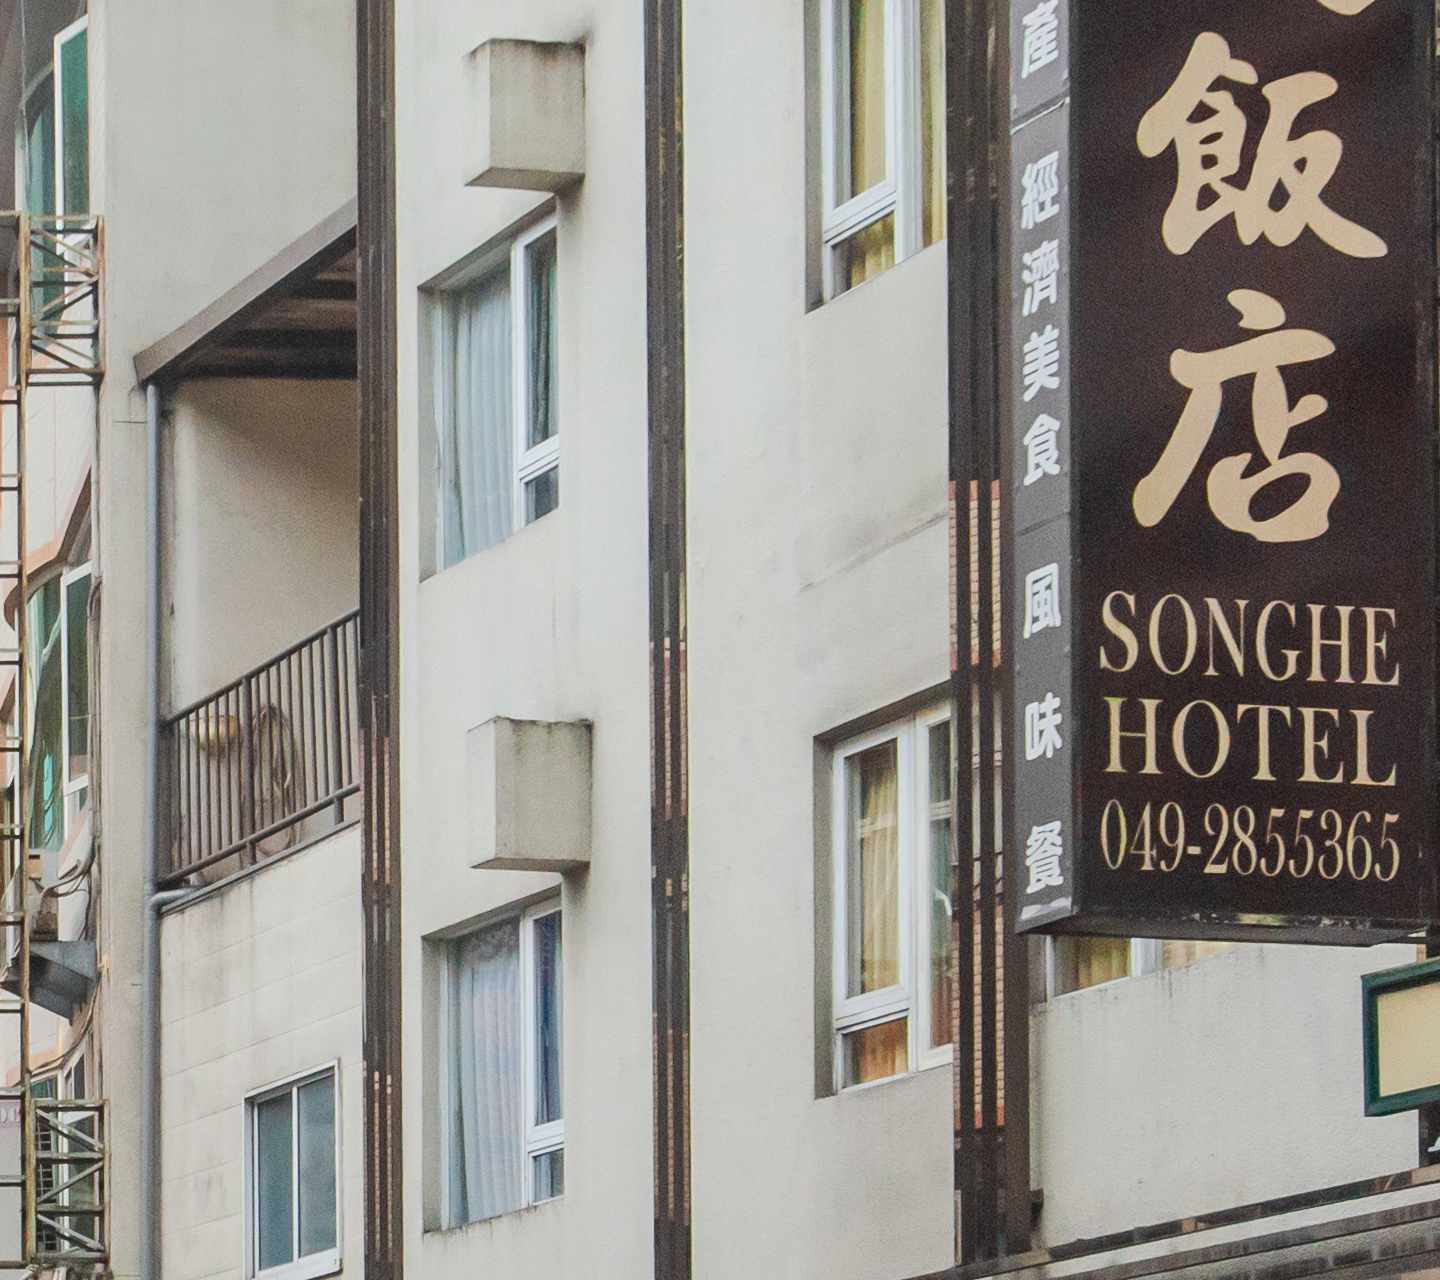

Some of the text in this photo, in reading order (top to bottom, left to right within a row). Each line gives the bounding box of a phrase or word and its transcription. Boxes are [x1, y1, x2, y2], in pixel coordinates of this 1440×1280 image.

[1019, 149, 1061, 487] 經濟美食
[1099, 590, 1401, 686] SONGHE
[1105, 697, 1397, 789] HOTEL
[1100, 798, 1401, 882] 049-2855365
